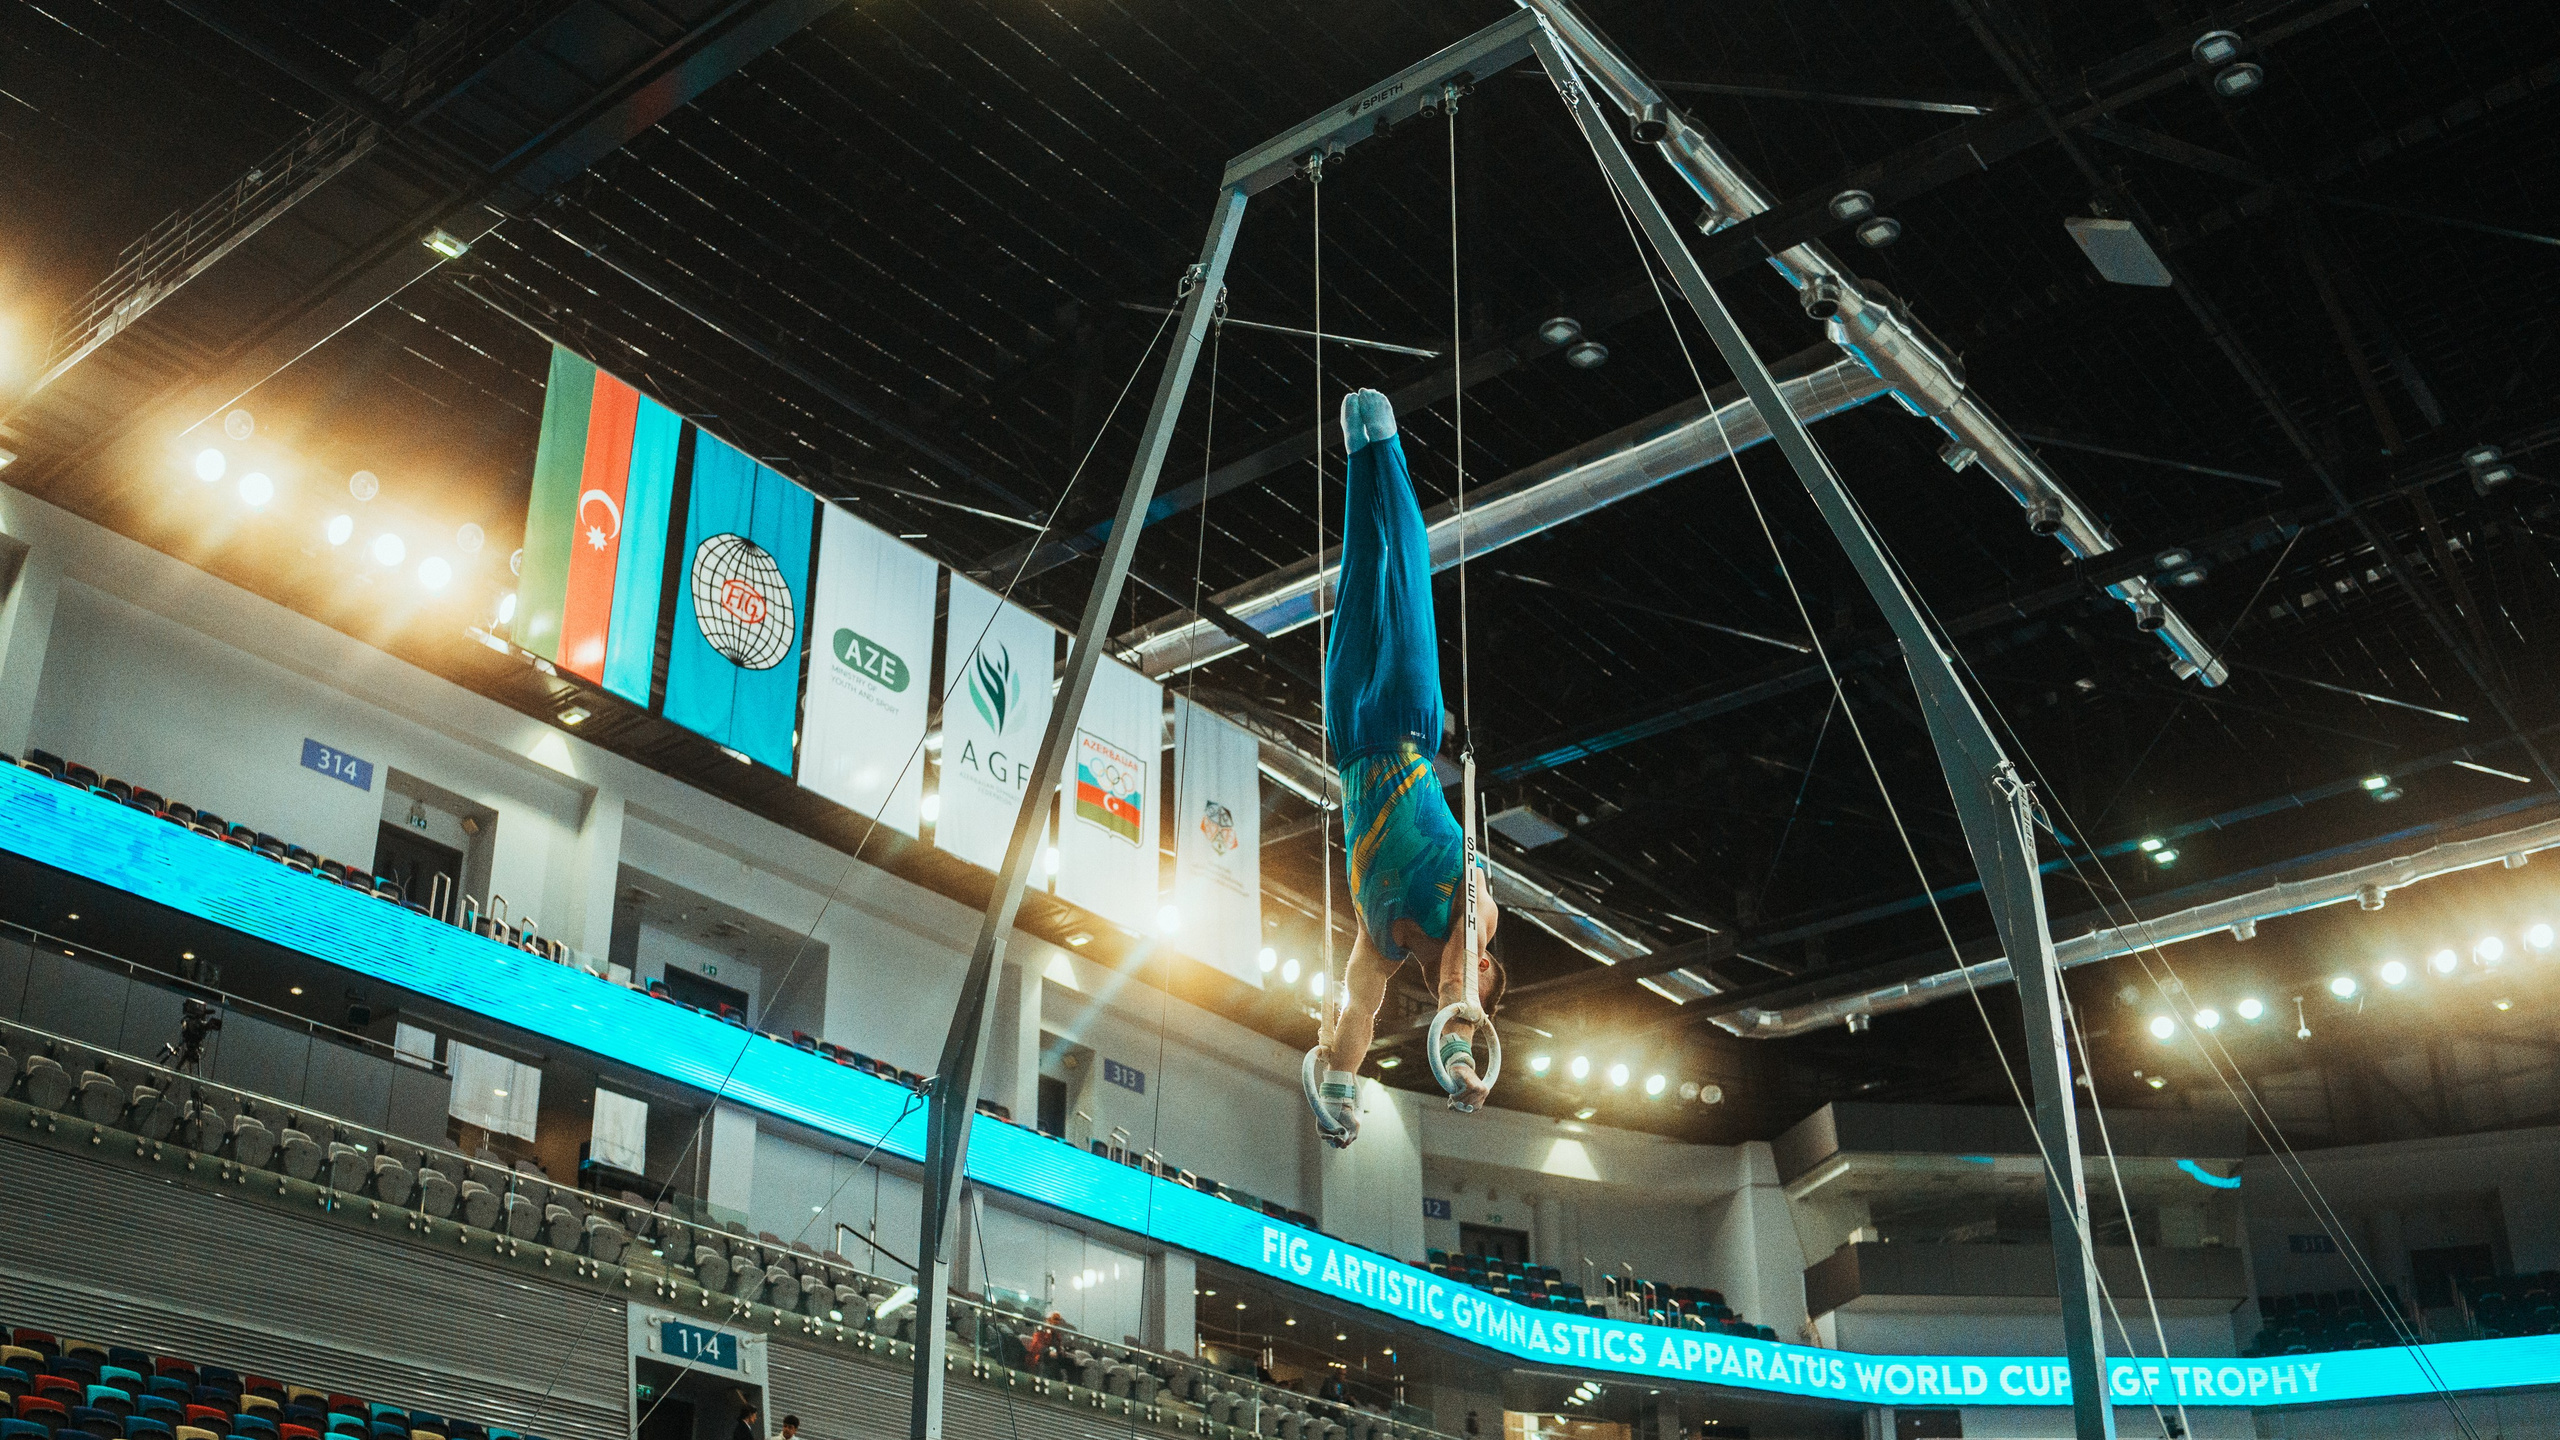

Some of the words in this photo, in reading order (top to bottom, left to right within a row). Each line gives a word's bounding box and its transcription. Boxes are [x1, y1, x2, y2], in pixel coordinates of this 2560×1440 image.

[1362, 82, 1404, 110] SPIETH
[844, 638, 897, 685] AZE
[831, 675, 857, 694] YOUTH
[858, 689, 875, 703] AND
[317, 748, 357, 781] 314
[960, 739, 1030, 790] AGF
[2019, 786, 2035, 850] SPIETH
[1467, 836, 1476, 931] SPIETH
[1112, 1064, 1136, 1088] 313
[1263, 1226, 1313, 1276] FIG
[1321, 1248, 1445, 1320] ARTISTIC
[1452, 1293, 1647, 1365] GYMNASTICS
[1657, 1337, 1847, 1390] APPARATUS
[1854, 1361, 1988, 1396] WORLD
[1999, 1365, 2071, 1397] CUP
[2109, 1365, 2160, 1397] GF
[2170, 1363, 2321, 1397] TROPHY
[679, 1328, 720, 1360] 114
